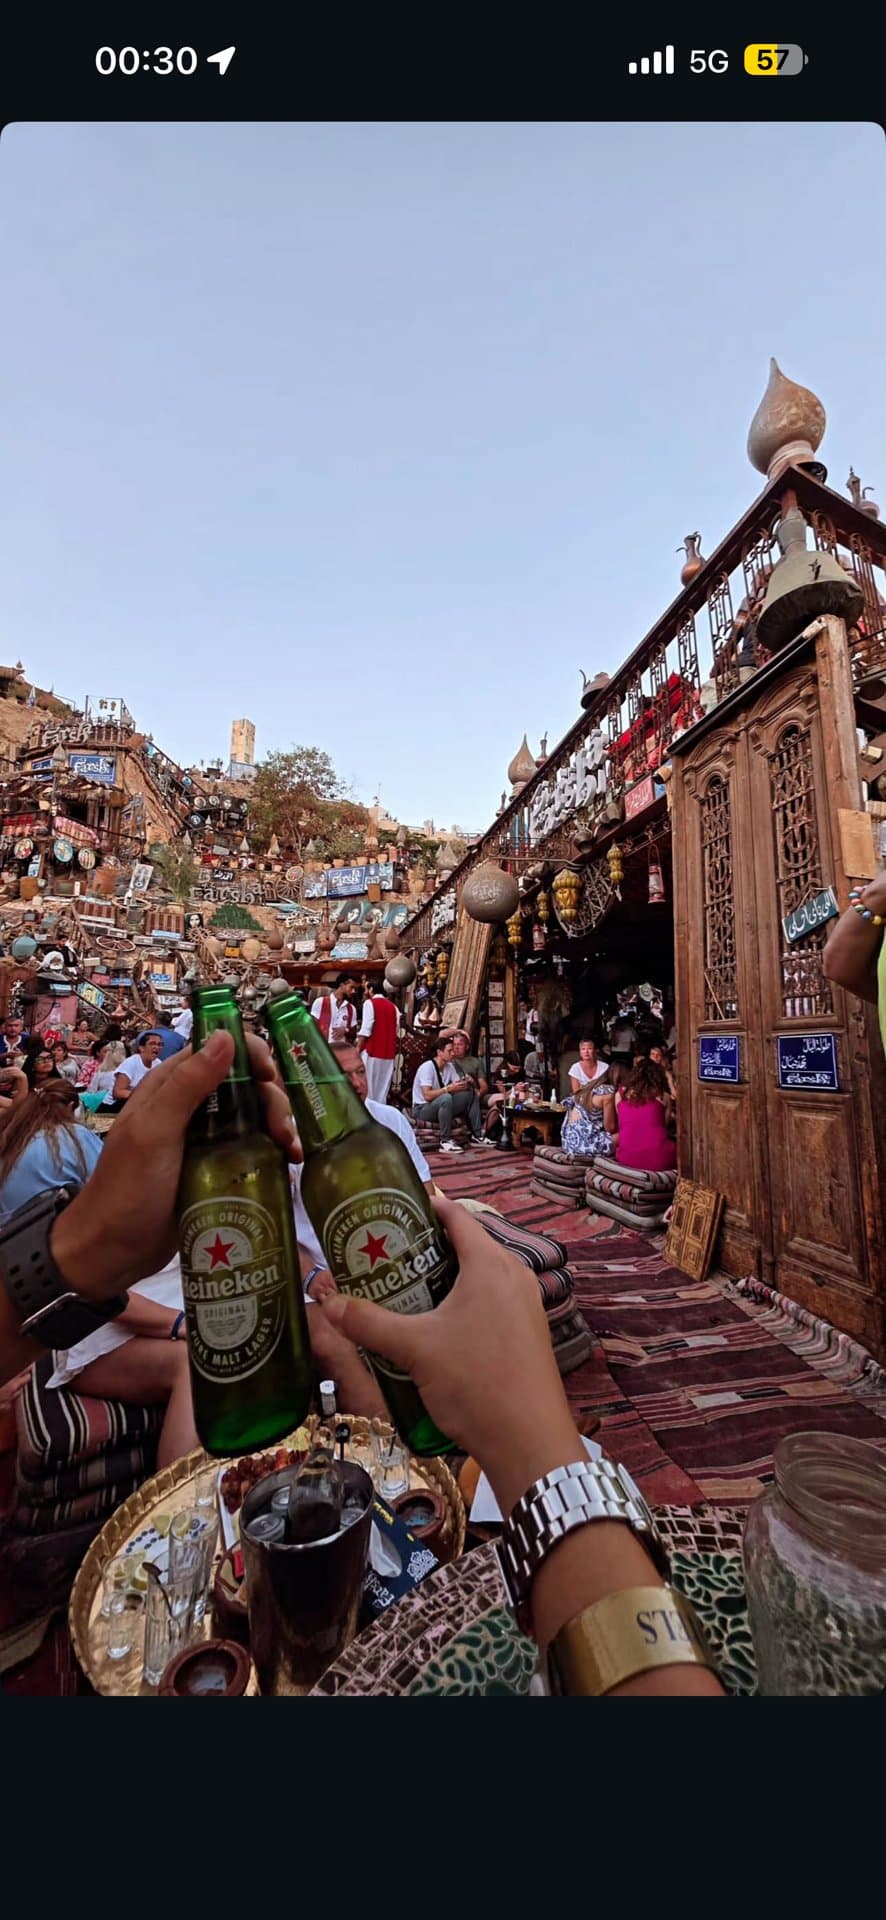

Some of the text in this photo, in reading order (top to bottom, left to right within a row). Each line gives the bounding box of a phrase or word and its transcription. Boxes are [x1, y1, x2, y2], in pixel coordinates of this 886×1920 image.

[219, 1212, 265, 1241] ORIGINAL
[333, 1203, 414, 1263] HEINEKEN ORIGINAL
[182, 1264, 280, 1299] Heineken
[211, 1351, 242, 1366] MALT
[244, 1317, 274, 1357] LAGER
